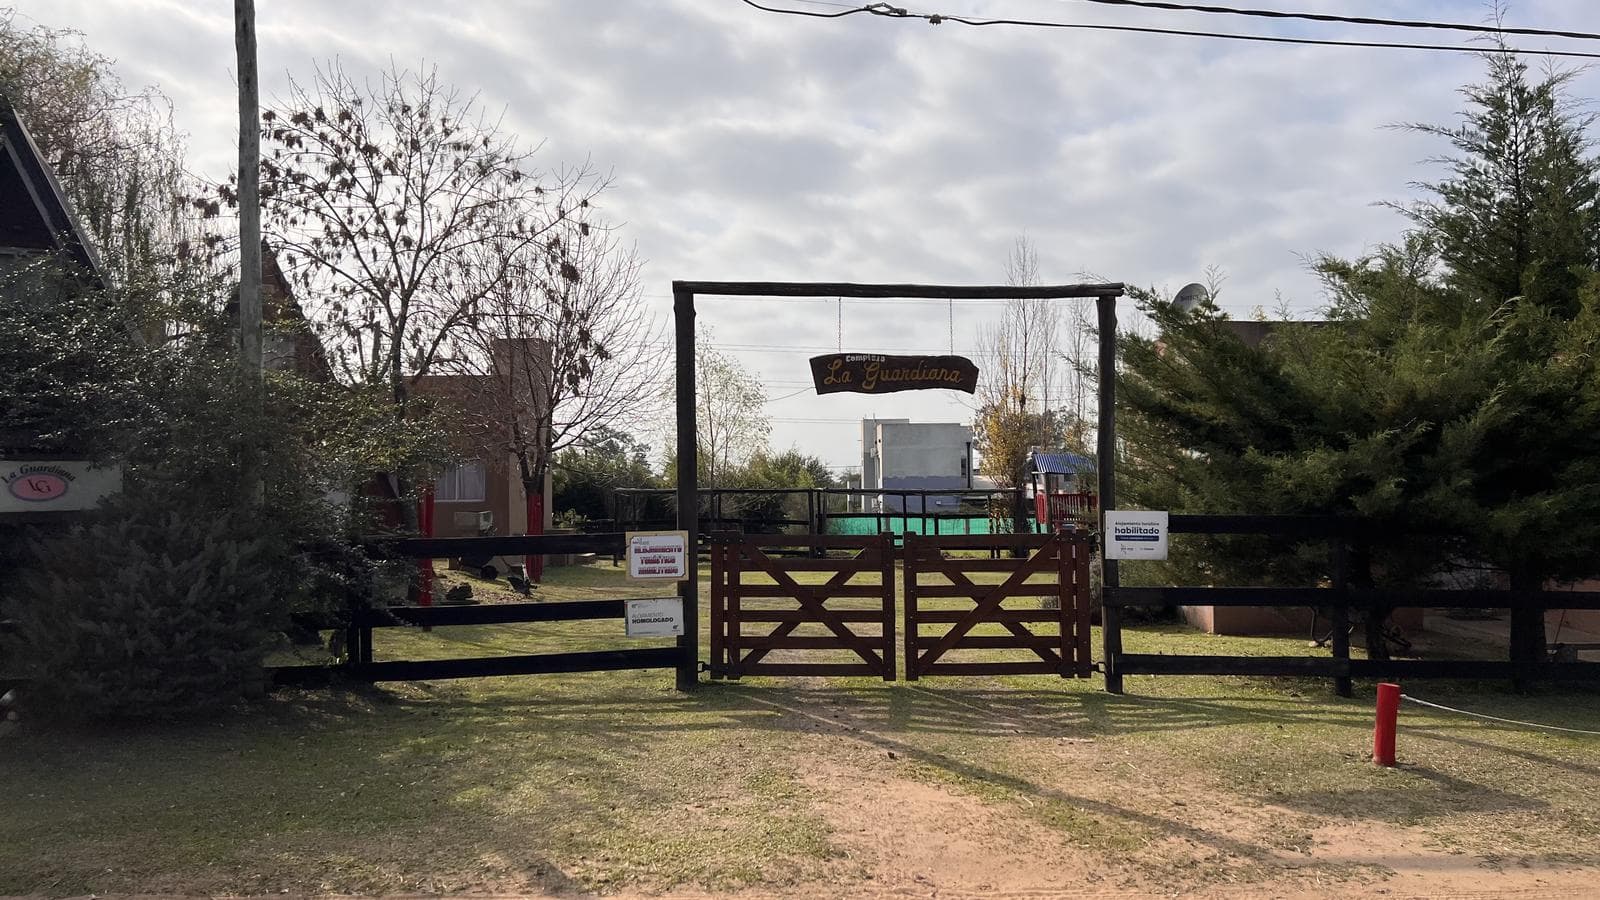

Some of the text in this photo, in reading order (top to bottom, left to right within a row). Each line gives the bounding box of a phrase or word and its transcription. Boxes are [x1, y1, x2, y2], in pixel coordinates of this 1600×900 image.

[824, 359, 964, 389] La Guardiana
[1, 464, 77, 484] La Guardiana
[1114, 526, 1160, 534] habilitado
[632, 617, 674, 625] HOMOLOGADO
